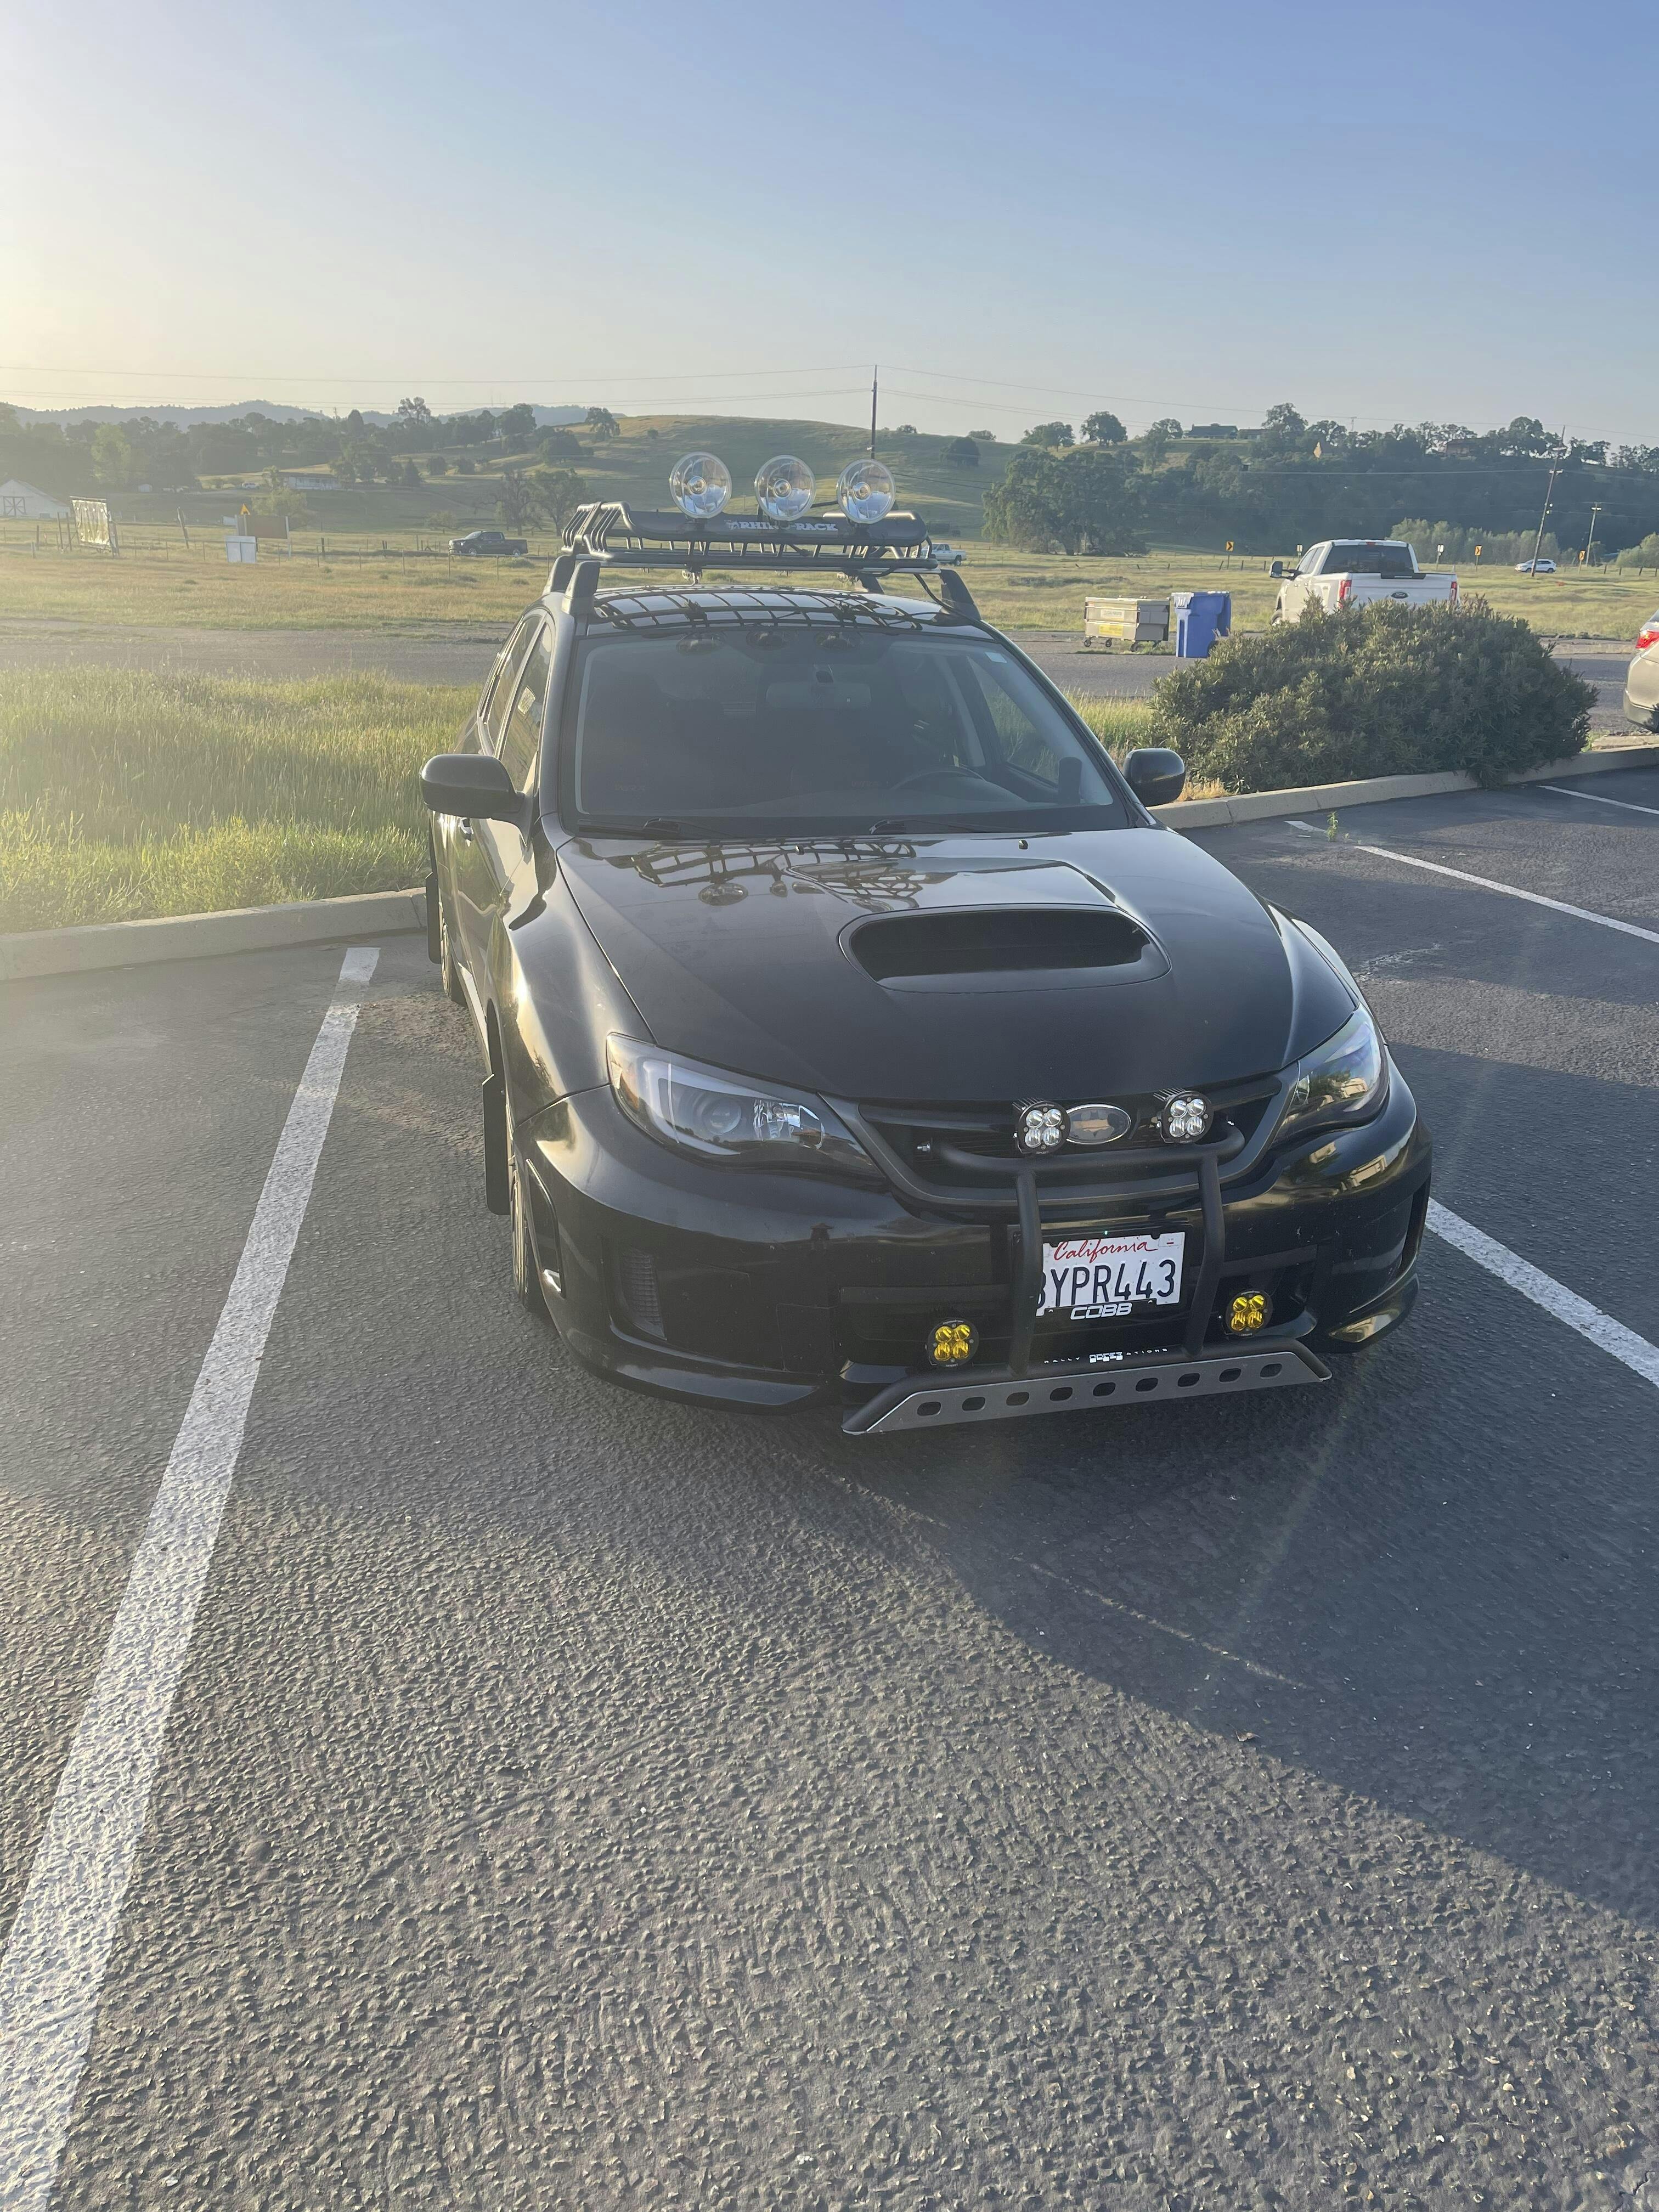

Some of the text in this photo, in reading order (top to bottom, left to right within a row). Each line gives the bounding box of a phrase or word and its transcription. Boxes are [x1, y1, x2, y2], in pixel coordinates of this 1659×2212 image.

[738, 521, 838, 531] RHIN-RACK
[1053, 1238, 1159, 1263] California
[1070, 1302, 1132, 1320] COBB
